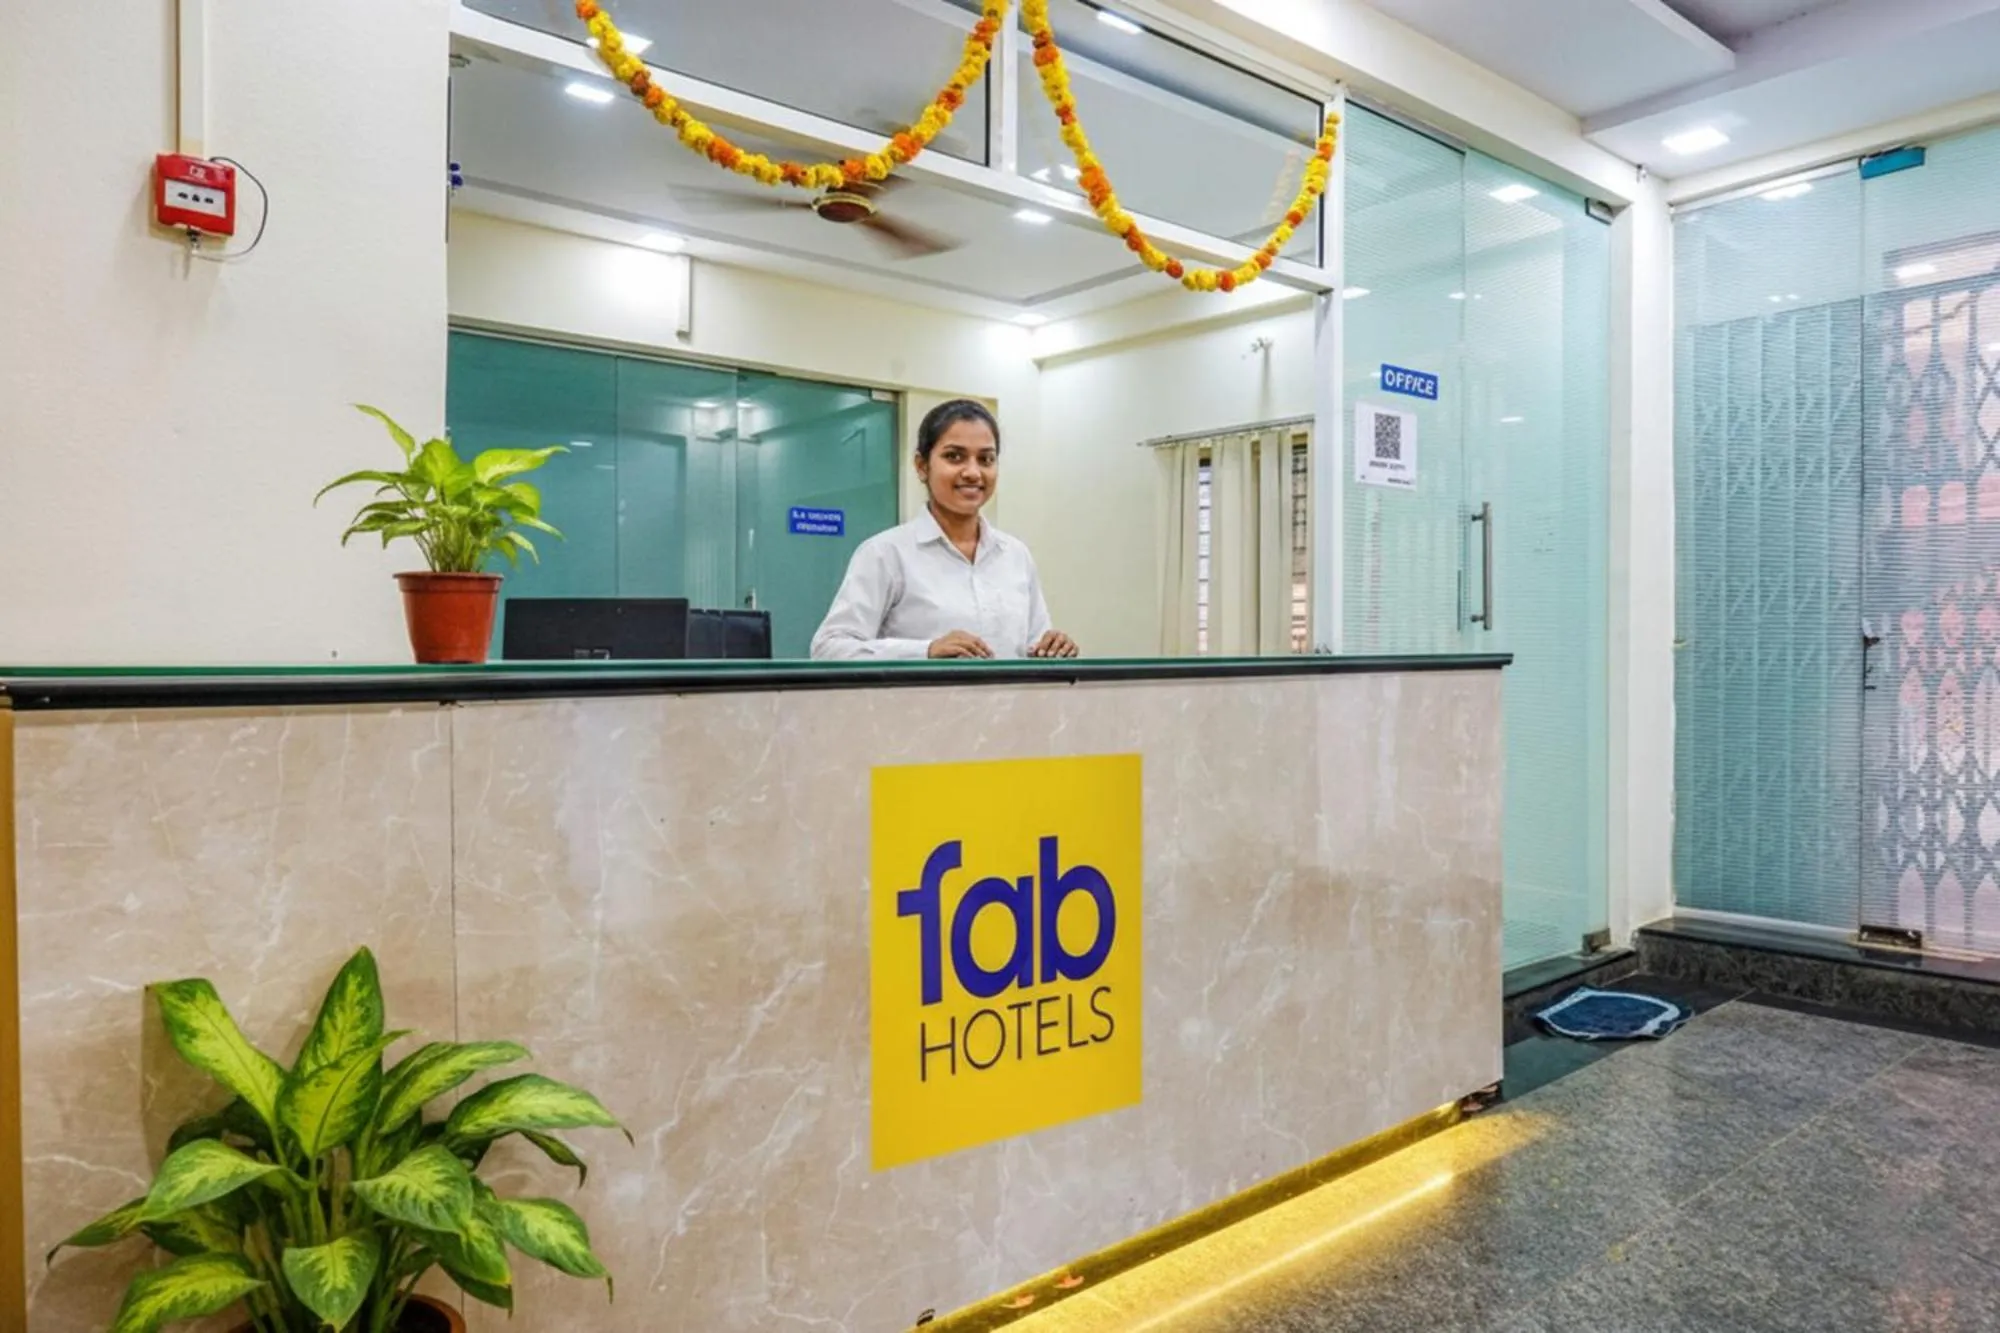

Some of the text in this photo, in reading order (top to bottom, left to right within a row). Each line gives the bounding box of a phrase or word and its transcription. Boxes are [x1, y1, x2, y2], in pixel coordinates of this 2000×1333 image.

[1385, 369, 1435, 396] OFFICE
[897, 836, 1116, 1006] fab
[921, 986, 1115, 1082] HOTELS
